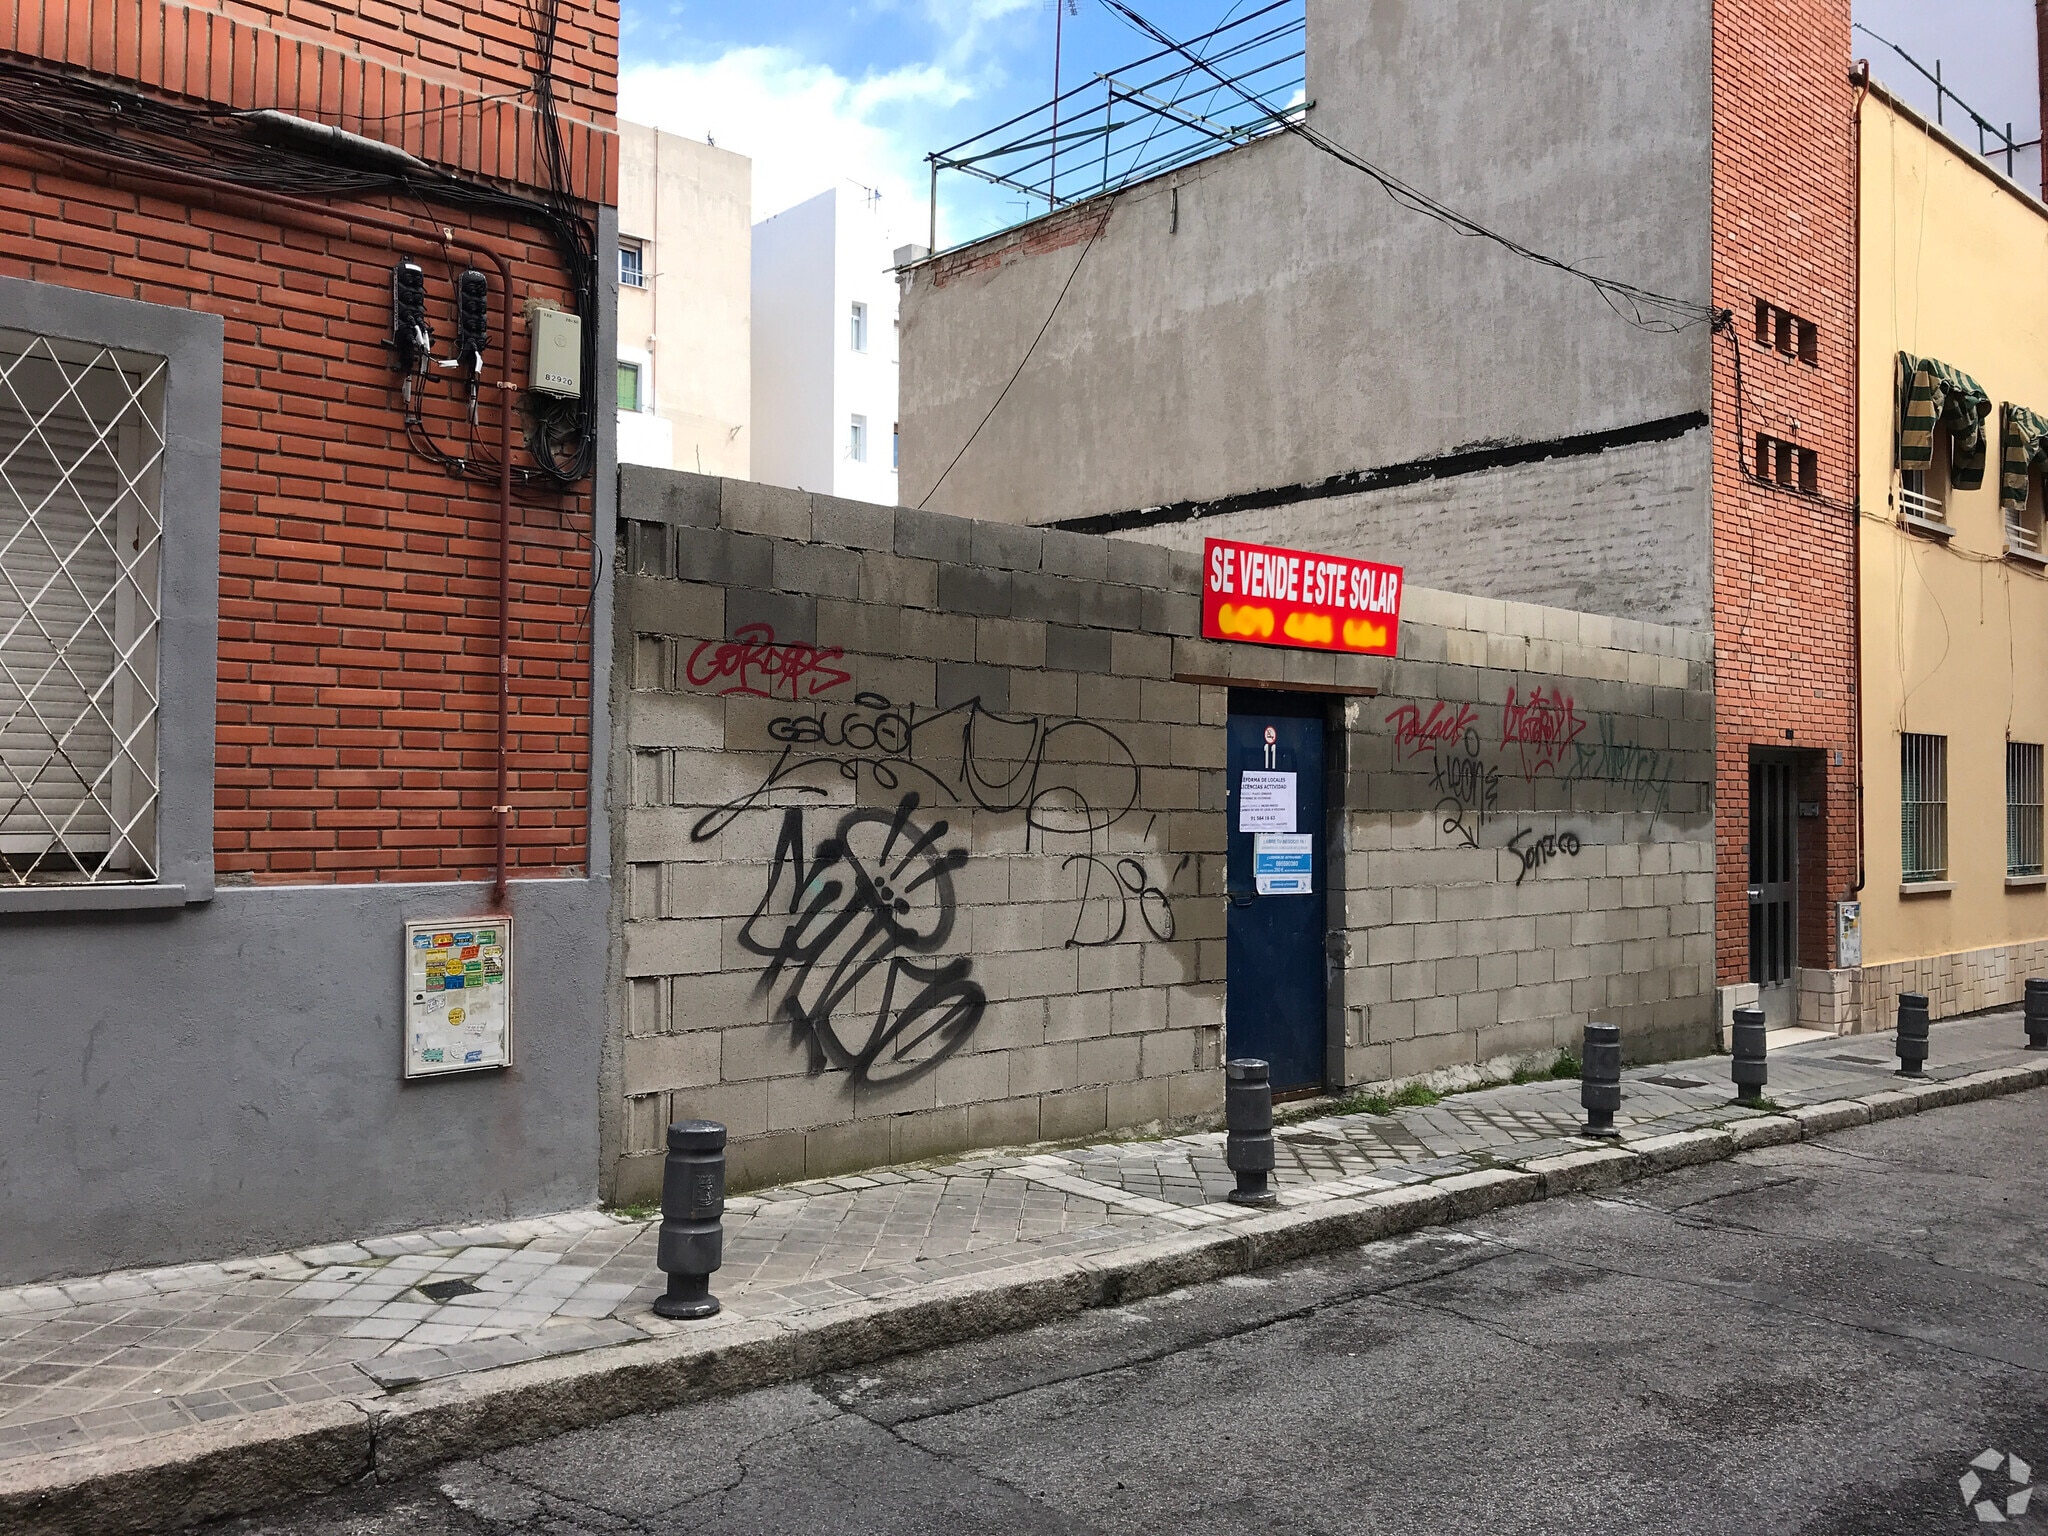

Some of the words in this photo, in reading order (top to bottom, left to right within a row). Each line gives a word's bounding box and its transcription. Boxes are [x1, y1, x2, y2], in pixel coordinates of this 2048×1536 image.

[545, 373, 572, 386] 82920
[1210, 546, 1235, 594] SE
[1239, 550, 1299, 601] VENDE
[1302, 560, 1347, 608] ESTE
[1349, 566, 1398, 615] SOLAR
[1263, 743, 1277, 769] 11
